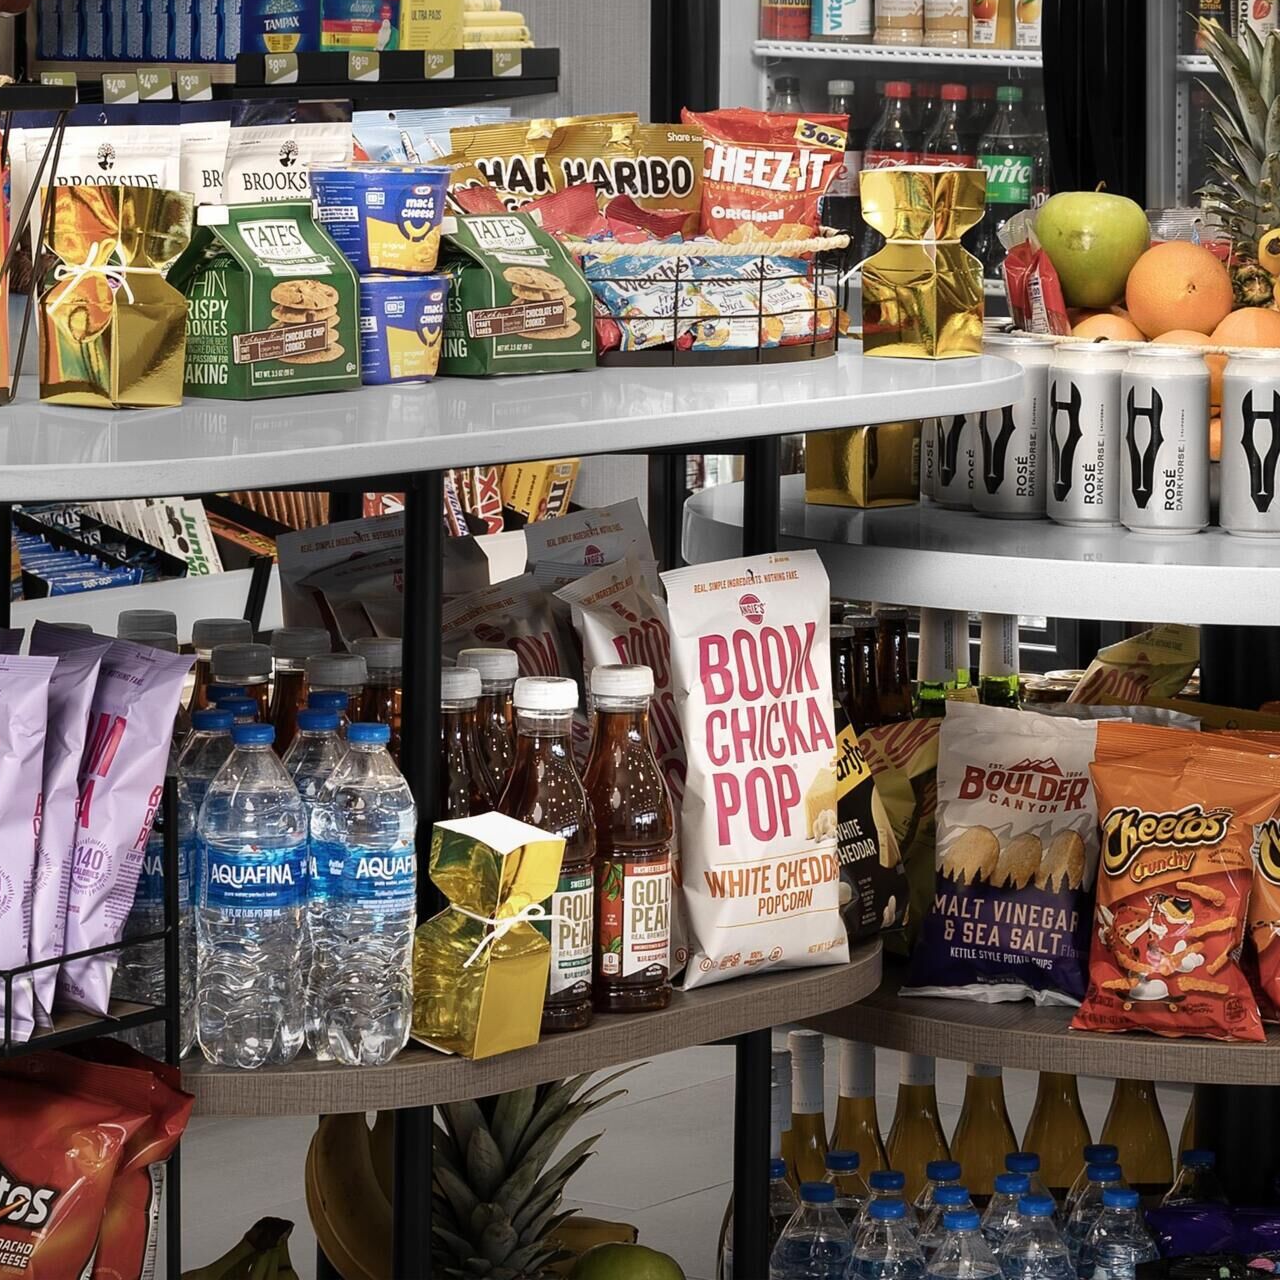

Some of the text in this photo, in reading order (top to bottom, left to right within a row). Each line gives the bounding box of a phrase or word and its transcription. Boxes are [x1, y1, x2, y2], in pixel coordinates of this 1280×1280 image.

[668, 131, 690, 142] Share
[562, 155, 693, 196] HARIBO
[243, 221, 302, 246] TATE'S
[286, 327, 325, 341] CHOCOLATE CHIP
[286, 340, 306, 351] COOKIES
[1083, 462, 1096, 505] ROSÉ
[1163, 469, 1176, 511] ROSÉ
[697, 622, 819, 705] BOOM
[706, 698, 834, 766] CHICKA
[958, 762, 1088, 812] BOULDER
[988, 792, 1058, 814] CANYON
[713, 765, 801, 846] POP
[1100, 805, 1234, 875] Cheetos
[211, 857, 294, 888] AQUAFINA
[1130, 851, 1194, 882] Crunchy
[758, 888, 812, 917] POPCORN
[932, 896, 1079, 931] MALT VINEGAR
[944, 922, 1062, 955] & SEA SALT
